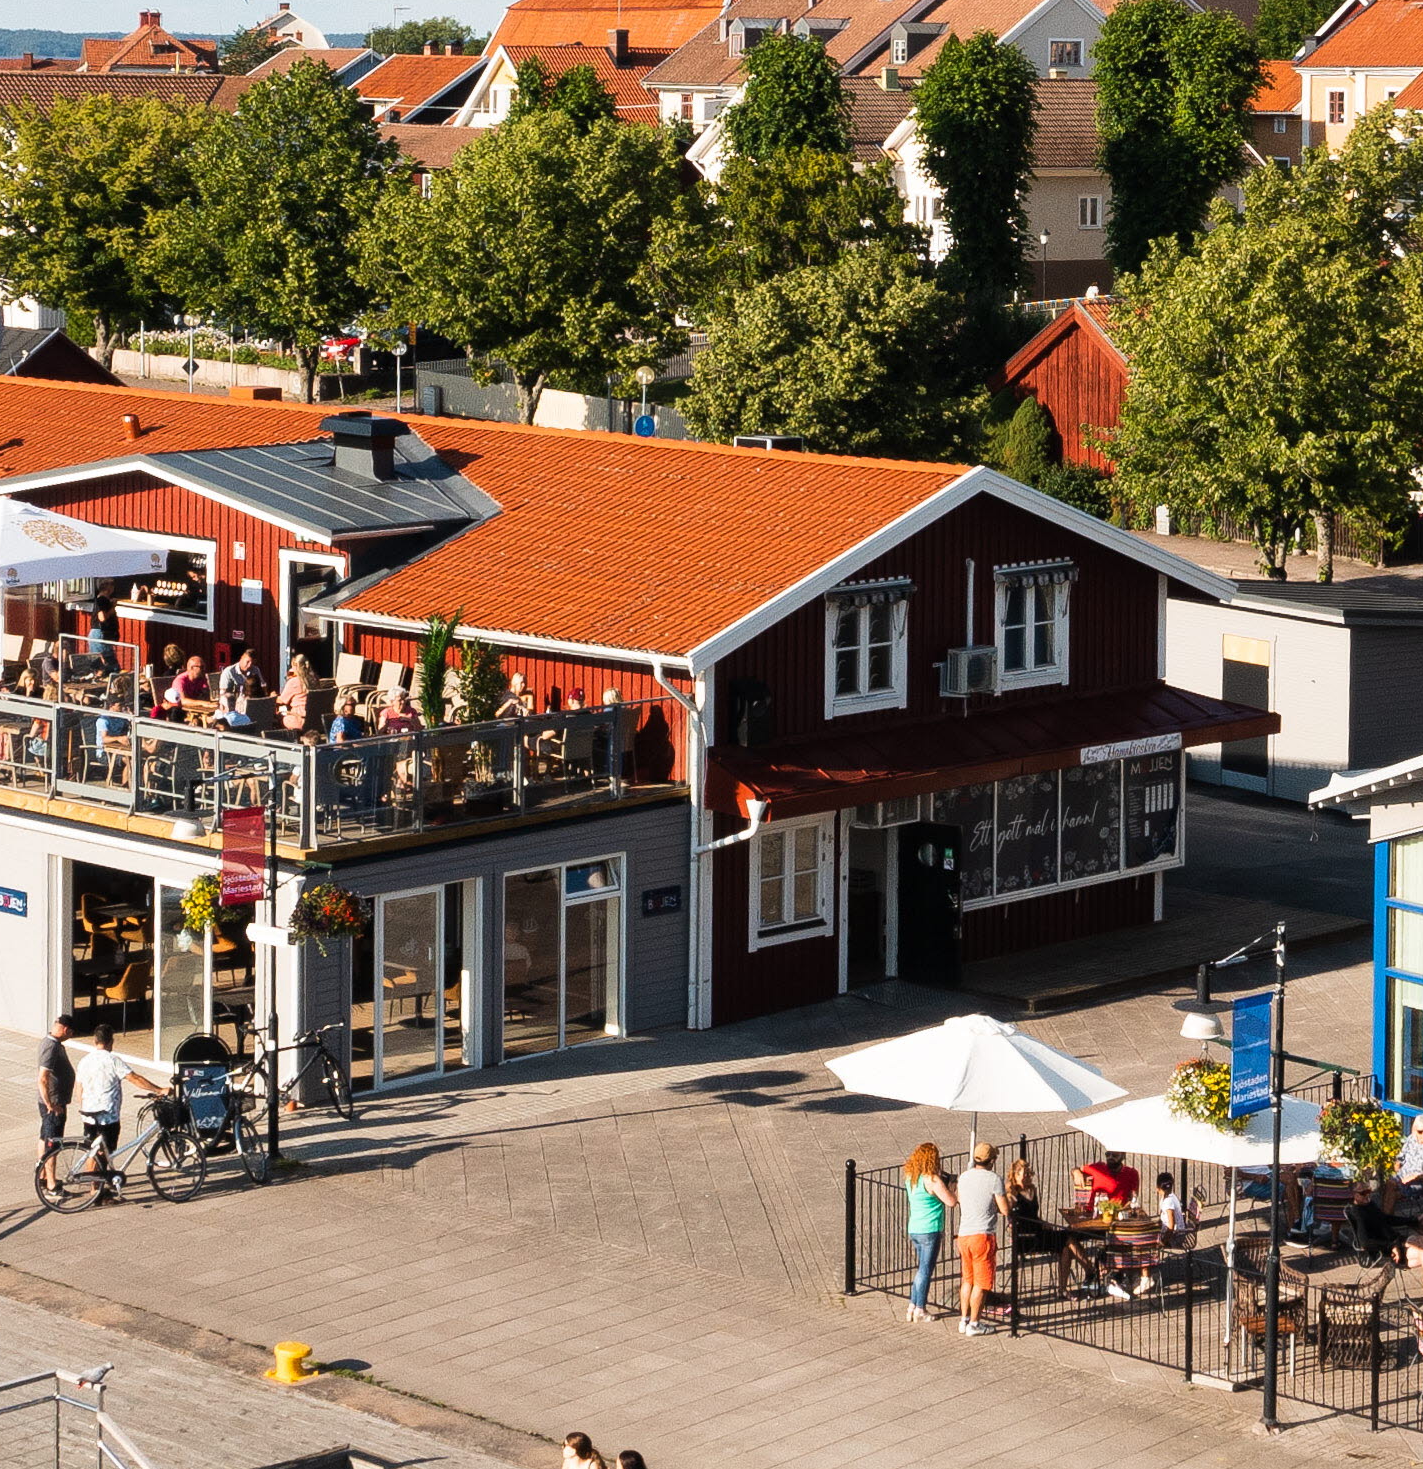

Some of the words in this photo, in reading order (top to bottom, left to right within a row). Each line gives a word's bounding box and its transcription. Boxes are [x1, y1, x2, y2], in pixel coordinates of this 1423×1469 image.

[1130, 755, 1174, 775] MJJEN
[970, 820, 993, 852] Ett
[997, 813, 1026, 854] gott
[223, 884, 262, 895] Mariestad
[647, 895, 678, 910] BJEN
[1233, 1074, 1268, 1092] Sjöstaden
[1233, 1085, 1269, 1105] Mariestad
